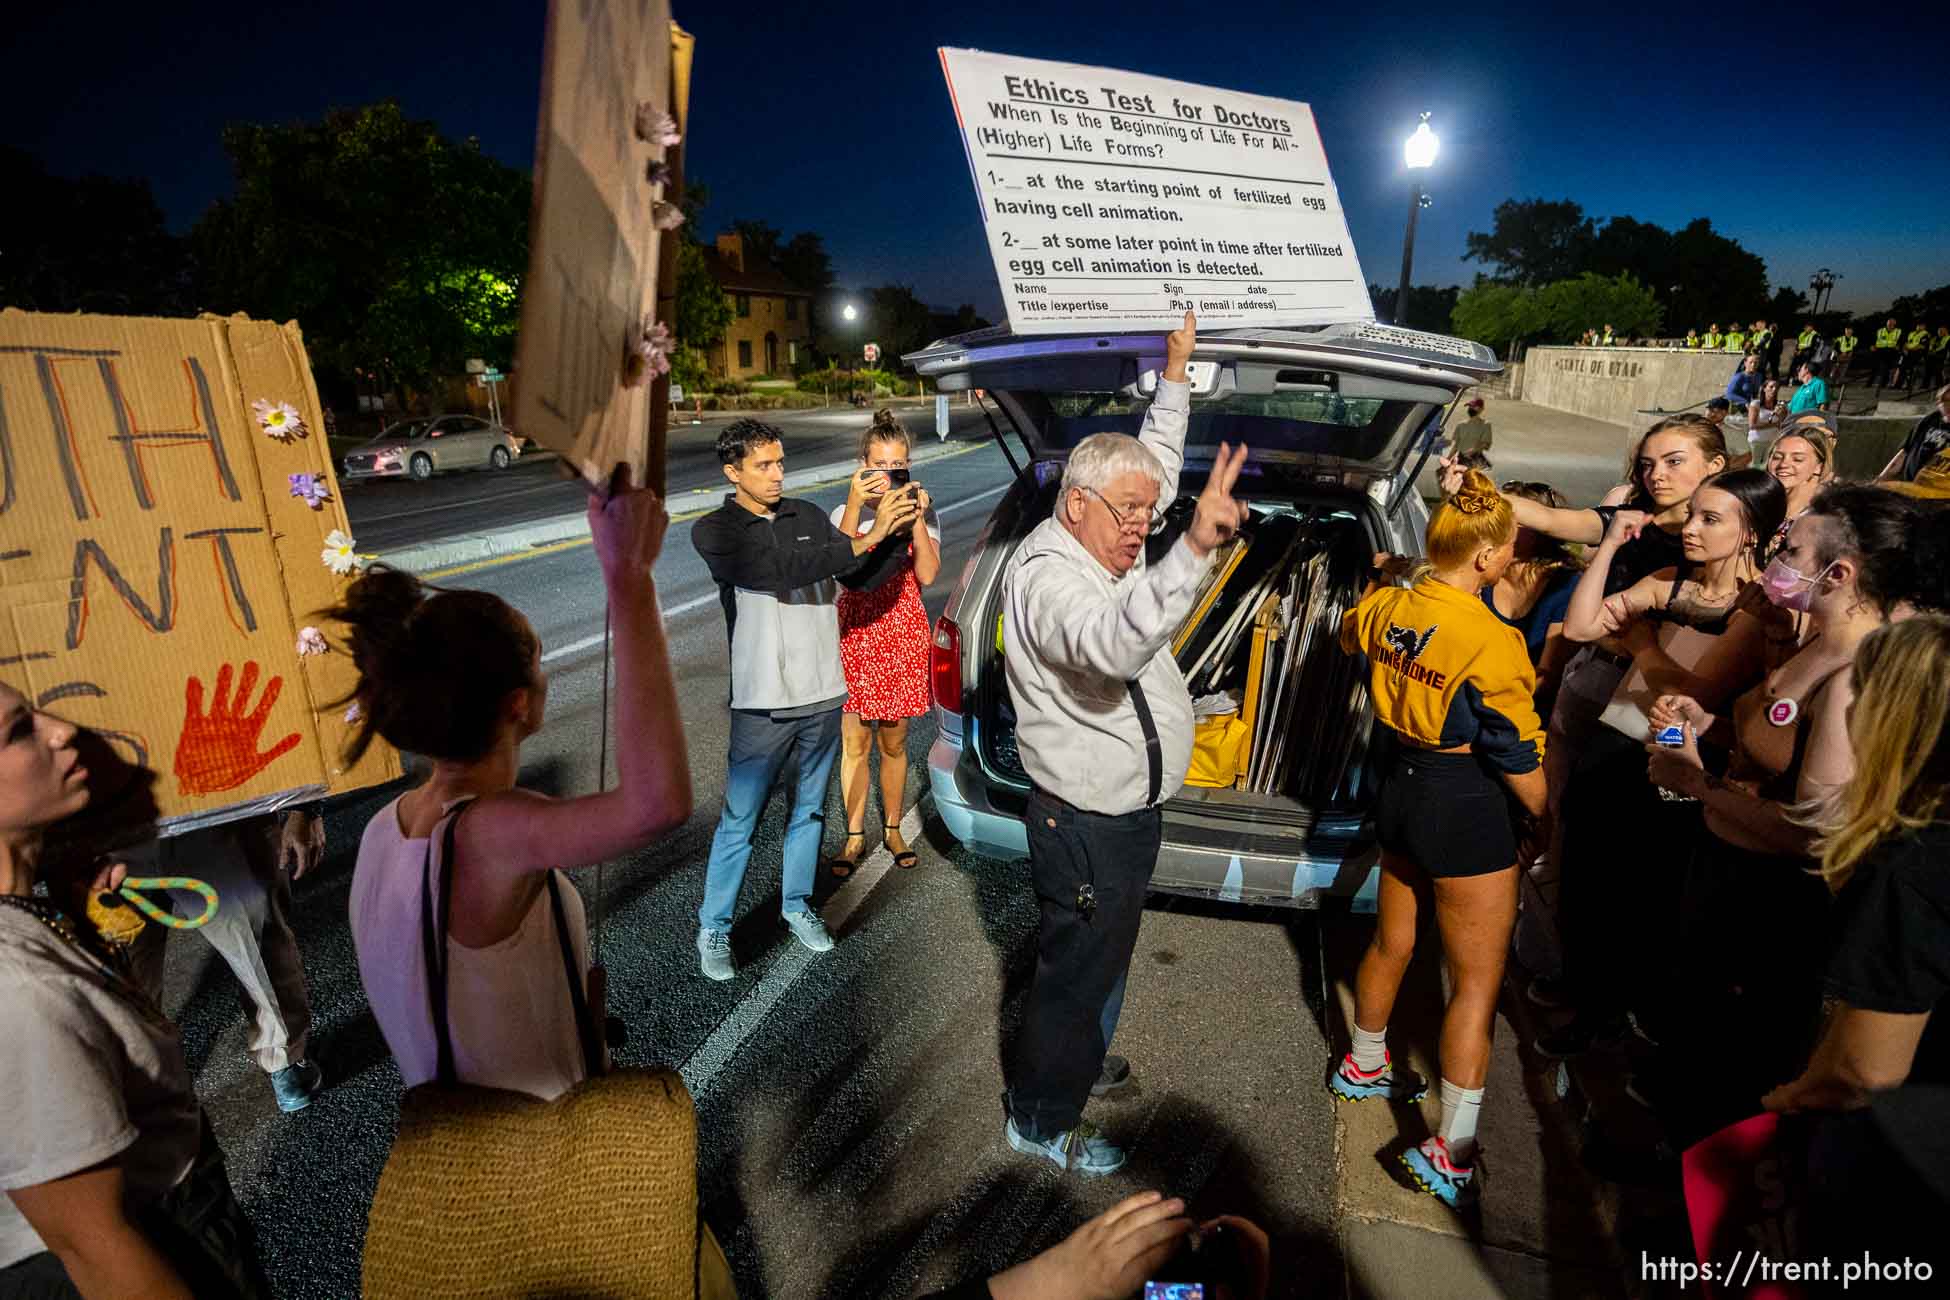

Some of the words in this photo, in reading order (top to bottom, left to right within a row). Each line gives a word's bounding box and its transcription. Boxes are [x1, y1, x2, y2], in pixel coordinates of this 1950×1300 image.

[1004, 75, 1090, 104] Ethics
[1101, 88, 1156, 113] Test
[1173, 98, 1202, 119] for
[1214, 105, 1291, 133] Doctors
[988, 102, 1042, 123] When
[1051, 108, 1068, 126] Is
[1077, 112, 1102, 129] the
[1110, 115, 1188, 142] Beginning
[1190, 127, 1204, 141] of
[1210, 128, 1236, 145] Life
[1242, 132, 1265, 149] For
[976, 127, 1052, 153] (Higher)
[1060, 134, 1093, 152] Life
[1104, 138, 1164, 158] Forms?
[1026, 173, 1046, 188] at
[1055, 174, 1085, 190] the
[1094, 177, 1159, 198] starting
[1162, 182, 1201, 199] point
[1208, 186, 1222, 199] of
[1233, 188, 1292, 205] fertilized
[1302, 196, 1326, 211] egg
[994, 197, 1057, 219] having
[1062, 202, 1094, 218] cell
[1098, 204, 1184, 222] animation.
[1042, 233, 1061, 248] at
[1065, 237, 1112, 250] some
[1115, 234, 1154, 250] later
[1159, 236, 1198, 254] point
[1200, 238, 1214, 252] in
[1218, 240, 1249, 255] time
[1252, 241, 1283, 256] after
[1286, 242, 1344, 257] fertilized
[1009, 259, 1046, 276] egg
[1052, 257, 1085, 272] cell
[1091, 258, 1172, 273] animation
[1178, 259, 1191, 274] is
[1196, 259, 1263, 277] detected.
[1014, 283, 1047, 294] Name
[1163, 283, 1184, 296] Sign
[1247, 284, 1268, 295] date
[1018, 300, 1047, 312] Title
[1199, 299, 1230, 312] (email
[1237, 299, 1277, 312] address)
[0, 346, 242, 522] TH
